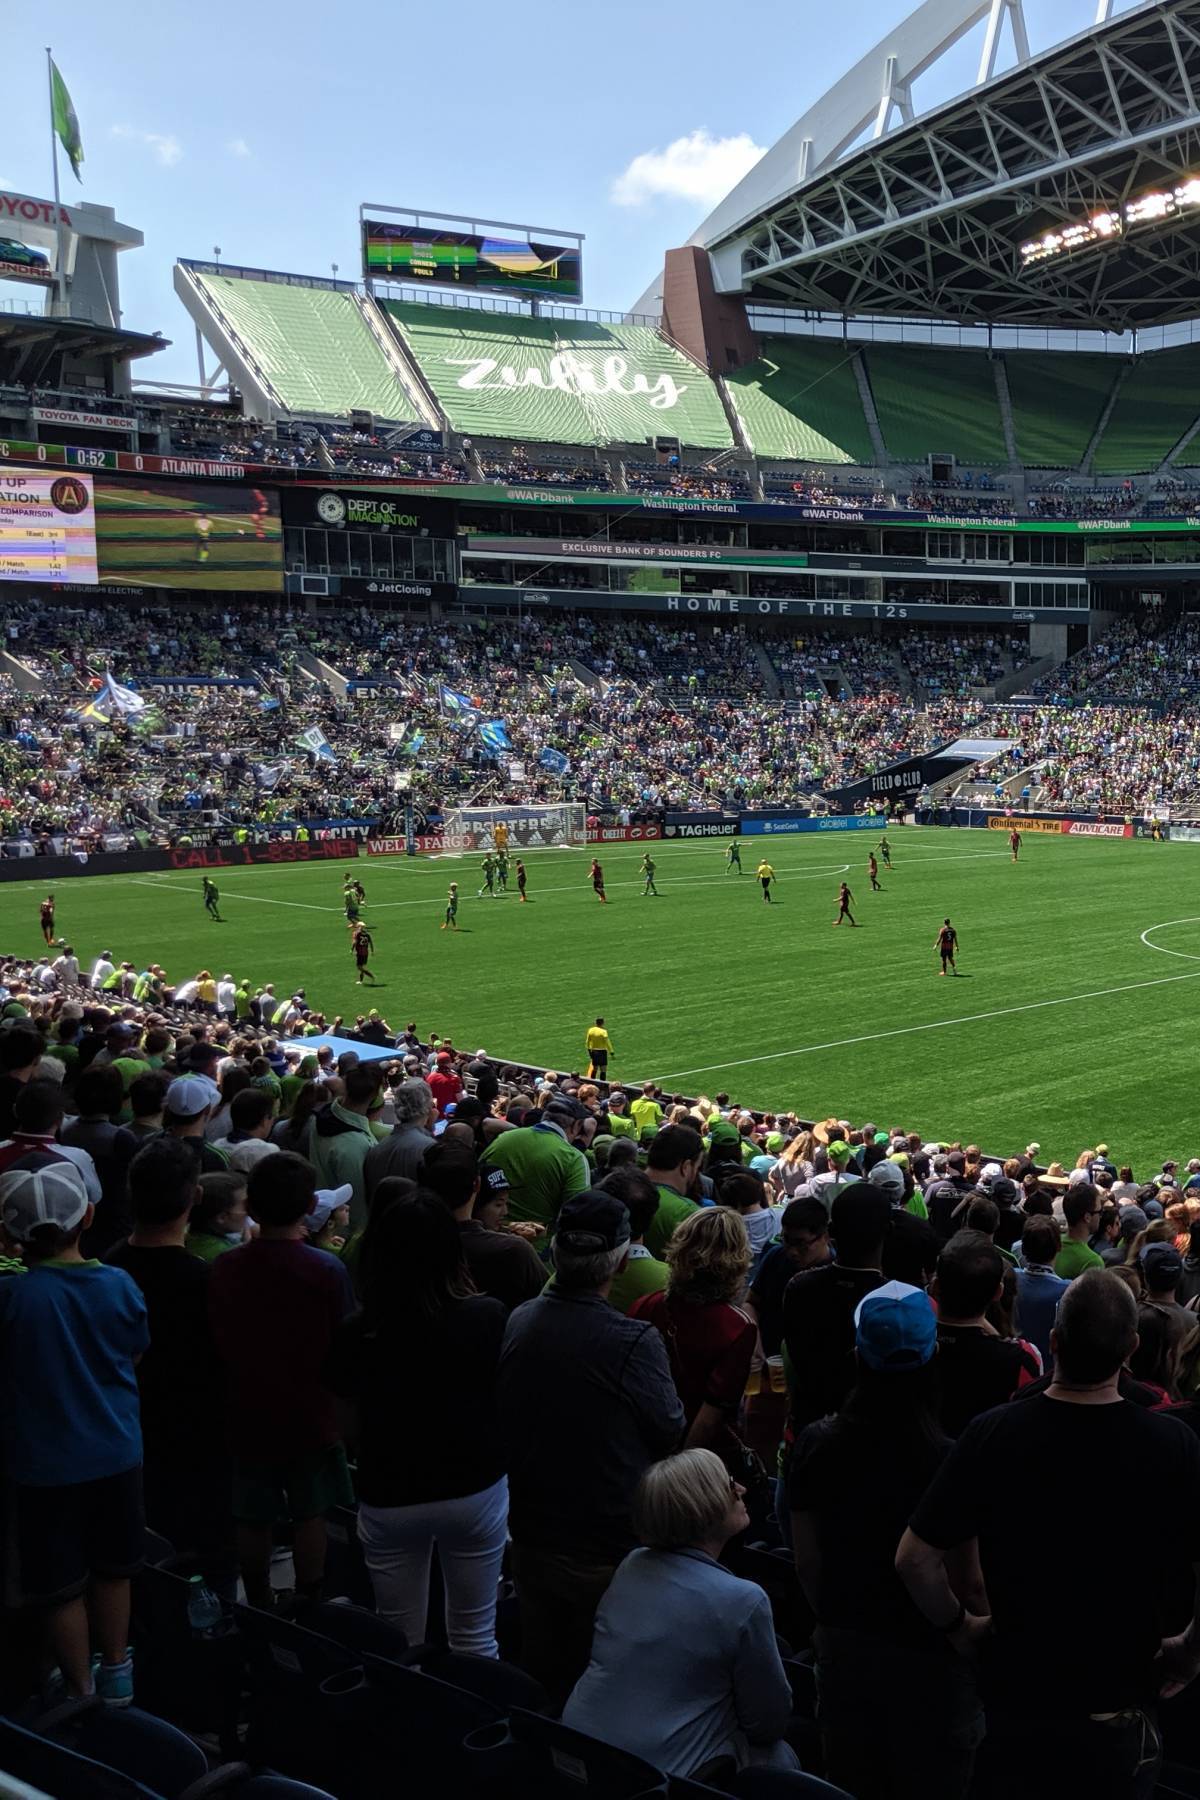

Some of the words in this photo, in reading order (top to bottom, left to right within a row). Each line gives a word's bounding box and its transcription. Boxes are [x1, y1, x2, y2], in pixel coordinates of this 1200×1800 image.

[0, 195, 72, 227] YOTA
[39, 410, 80, 423] TOYOTA
[83, 415, 102, 424] FAN
[106, 417, 134, 428] DECK
[0, 442, 9, 457] C
[38, 446, 46, 461] 0
[77, 451, 105, 467] 0:52
[135, 456, 144, 471] 0
[162, 459, 208, 476] ATLANTA
[208, 464, 245, 478] UNITED
[6, 477, 26, 488] UP
[507, 490, 574, 503] @WAFDbank
[1, 507, 54, 518] COMPARISON
[347, 499, 378, 512] DEPT
[380, 502, 397, 514] OF
[642, 498, 701, 512] Washington
[348, 511, 418, 527] IMAGINATION
[802, 508, 864, 521] @WAFDbank
[927, 514, 981, 527] Washington
[1077, 519, 1131, 530] @WAFDbank
[562, 543, 613, 554] EXCLUSIVE
[615, 545, 640, 555] BANK
[643, 547, 655, 556] OF
[658, 547, 707, 557] SOUNDERS
[709, 549, 721, 558] FC
[63, 584, 107, 594] MITSUBISHI
[108, 586, 143, 596] ELECTRIC
[379, 583, 432, 596] JetClosing
[668, 599, 740, 612] HOME
[758, 601, 788, 614] OF
[807, 602, 853, 616] THE
[872, 605, 908, 618] 12s
[872, 775, 893, 792] FIELD
[902, 770, 921, 786] CLUB
[773, 822, 799, 831] SeatGeek
[990, 815, 1034, 829] Continental
[1042, 822, 1060, 831] TIRE
[1069, 822, 1125, 836] ADVOCARE
[329, 826, 370, 843] CITY
[424, 835, 472, 850] FARGO
[170, 849, 232, 868] CALL
